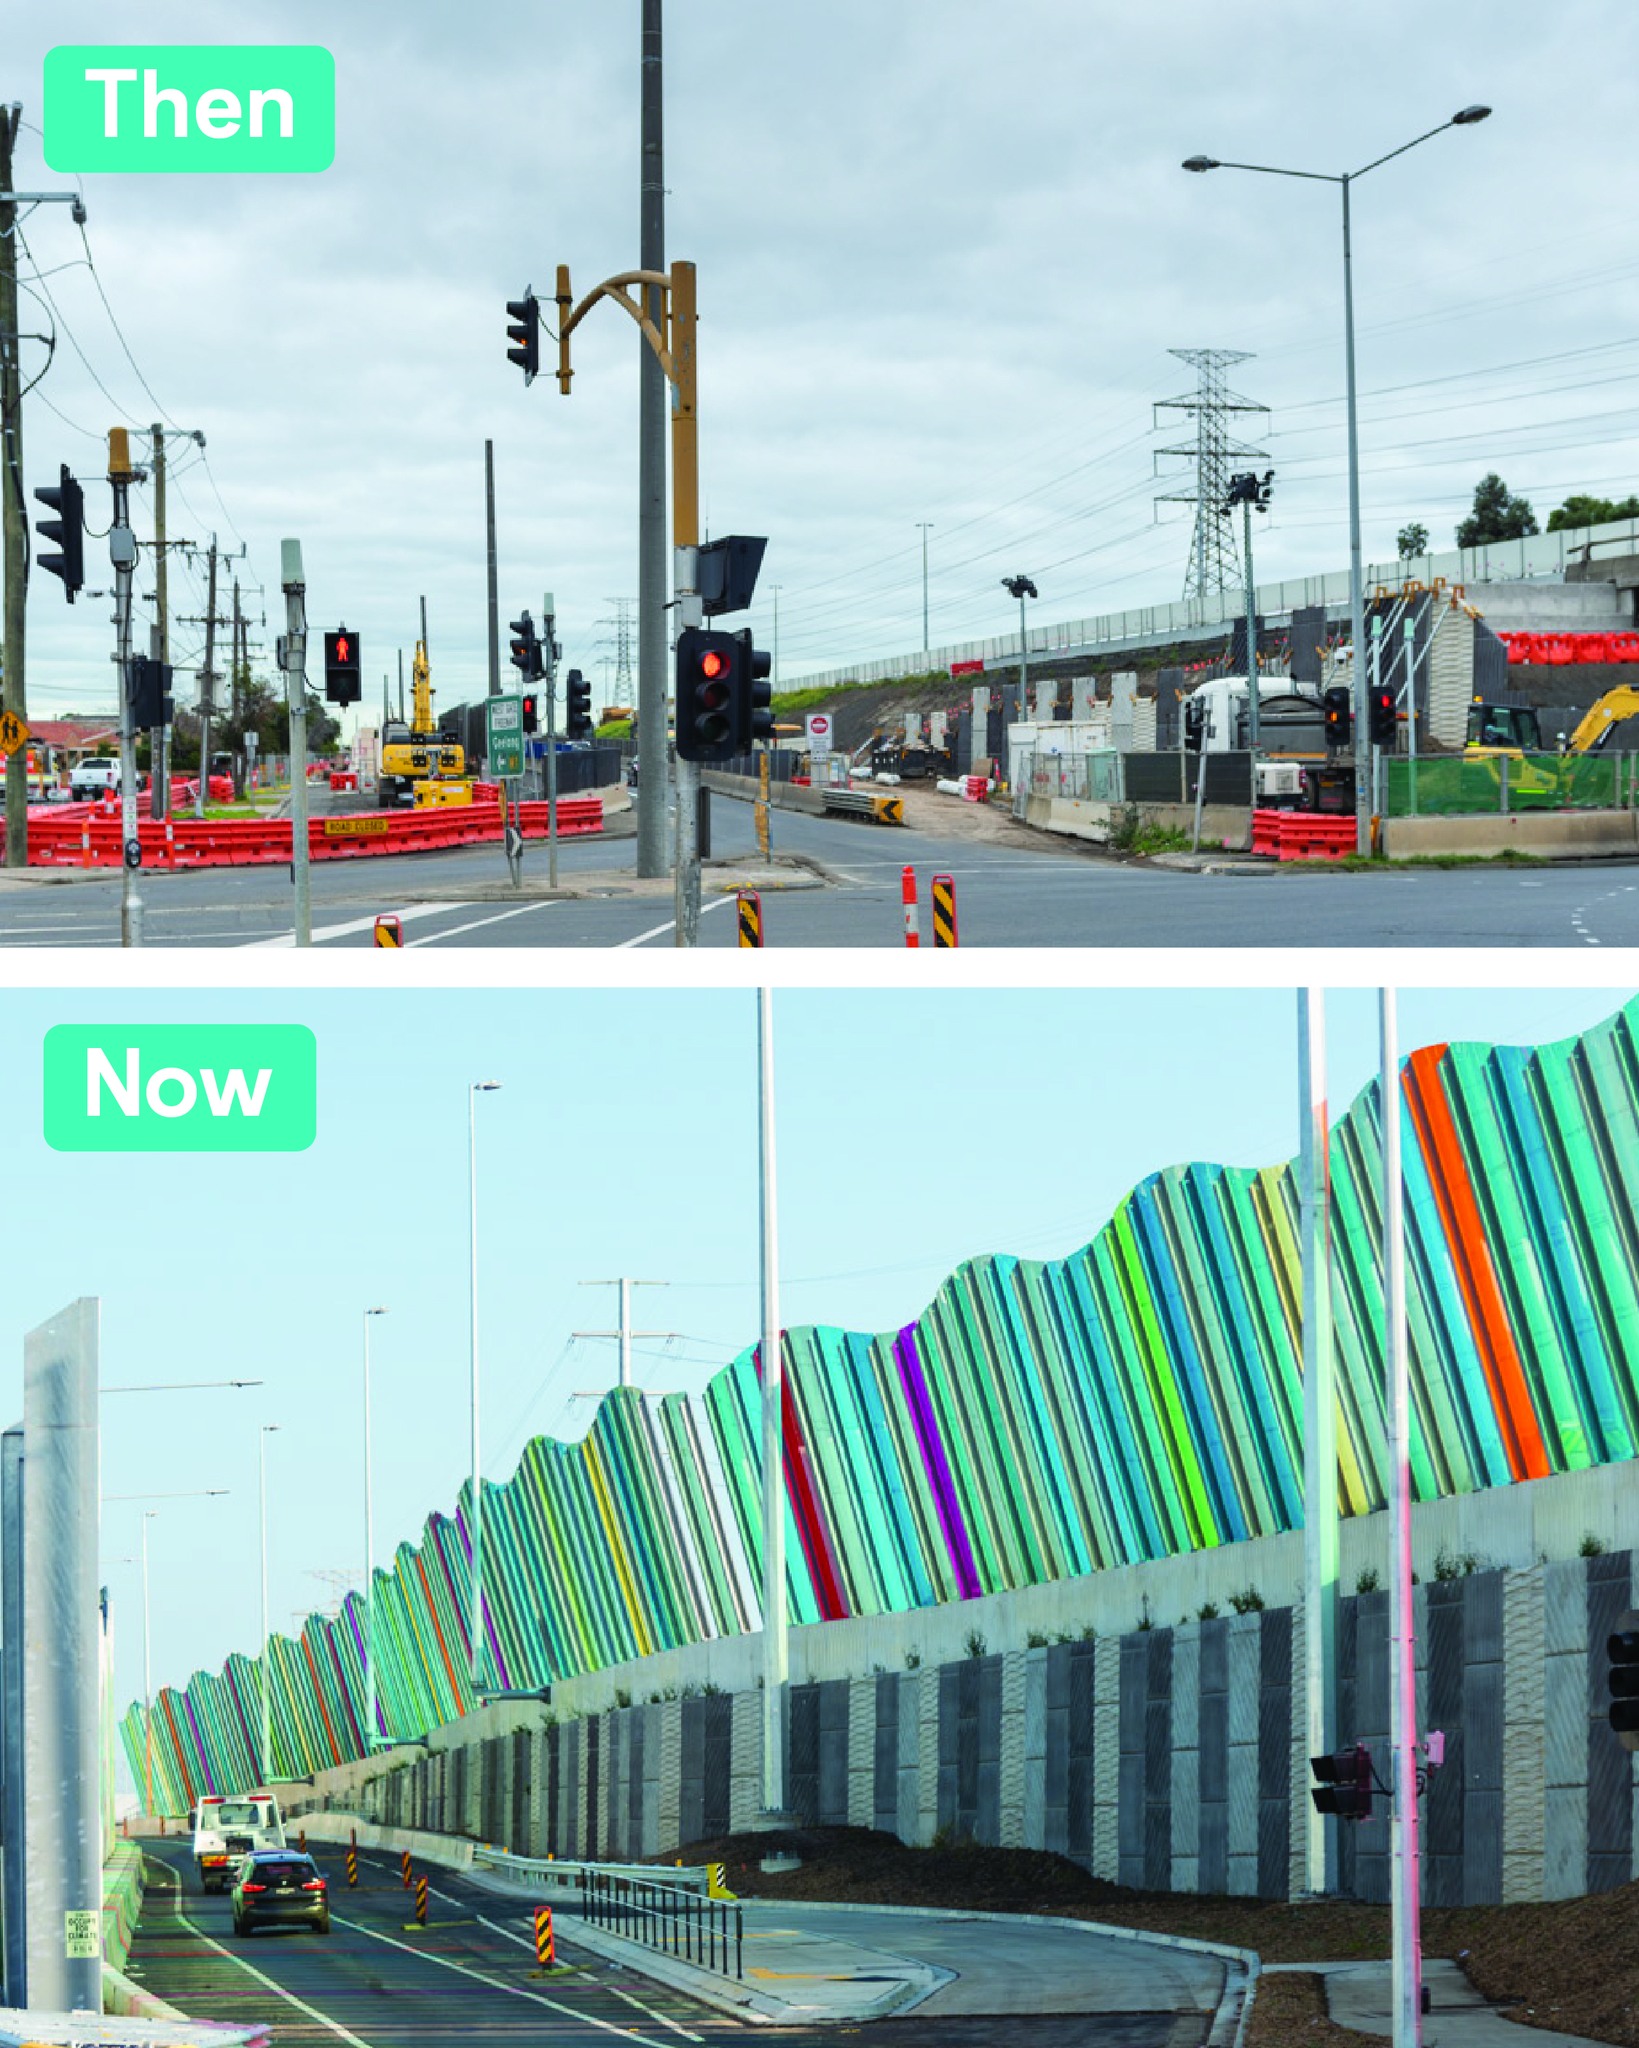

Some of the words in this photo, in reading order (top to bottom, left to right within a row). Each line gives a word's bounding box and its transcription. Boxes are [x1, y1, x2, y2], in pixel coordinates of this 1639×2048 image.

[492, 736, 520, 751] Geelong
[330, 822, 350, 832] ROAD
[355, 820, 384, 831] CLOSED
